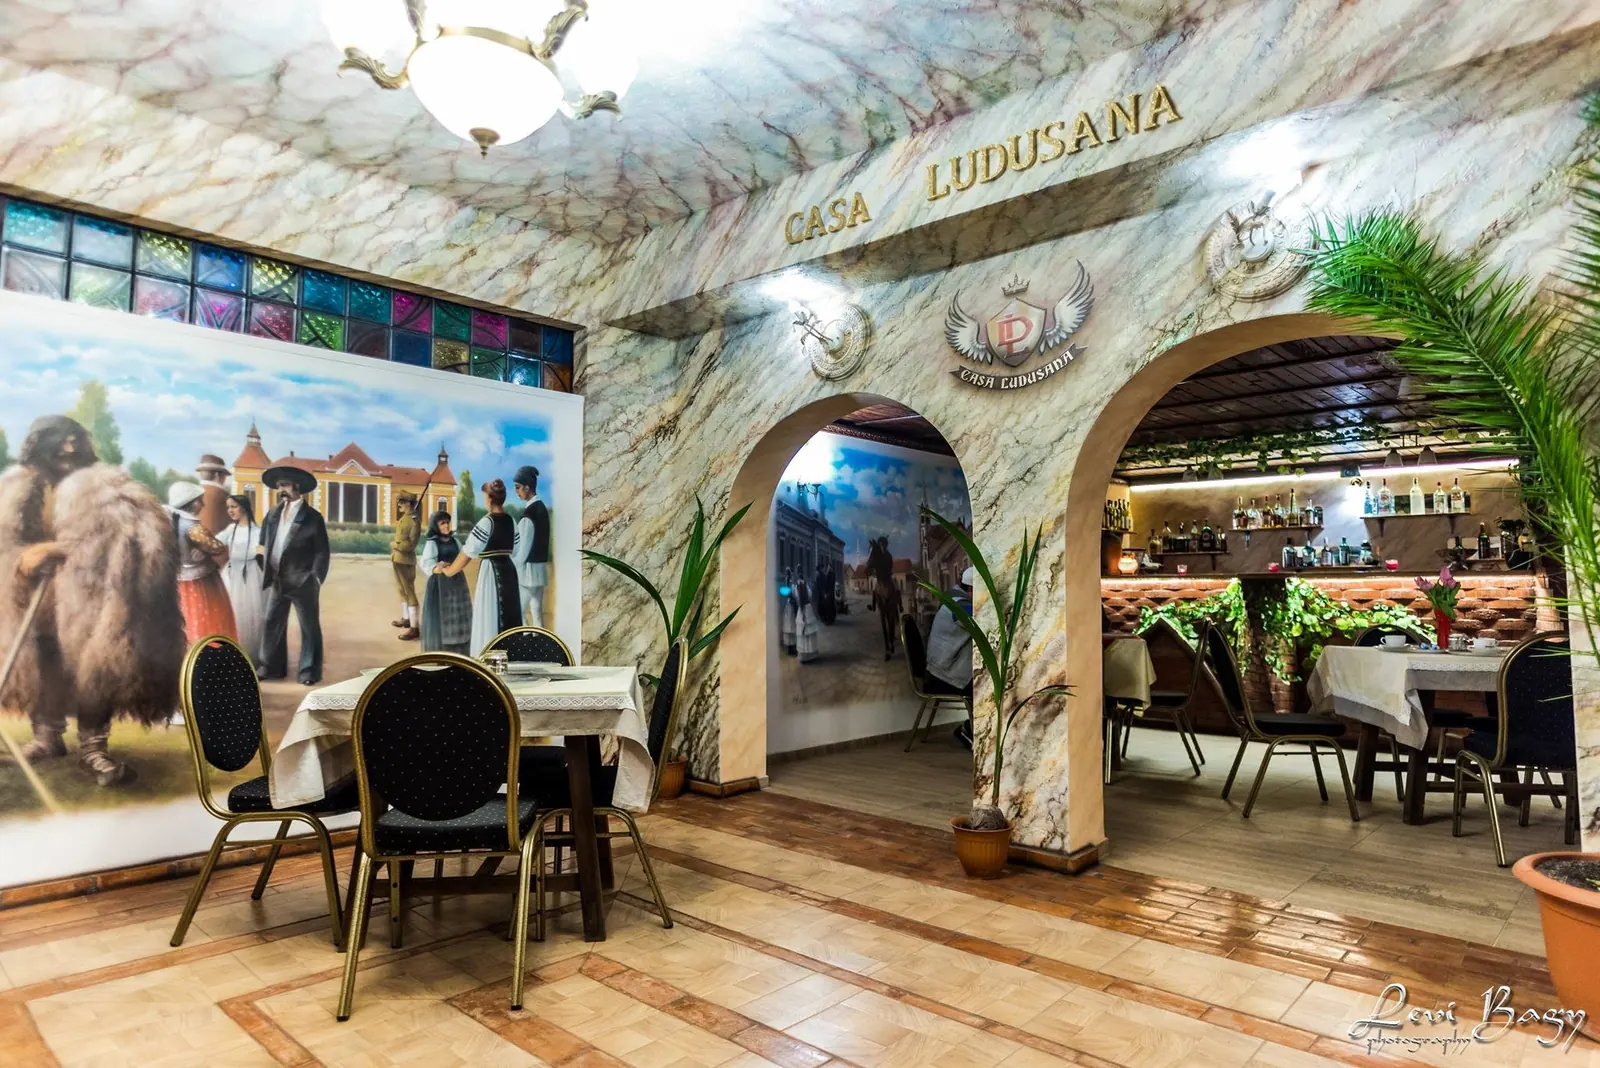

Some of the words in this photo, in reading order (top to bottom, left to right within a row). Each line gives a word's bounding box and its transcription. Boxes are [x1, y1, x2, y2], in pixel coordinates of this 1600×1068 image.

[785, 192, 871, 245] CASA
[926, 83, 1182, 201] LUDUSANA
[960, 370, 995, 389] CASA
[1001, 350, 1075, 389] LUDUSANA
